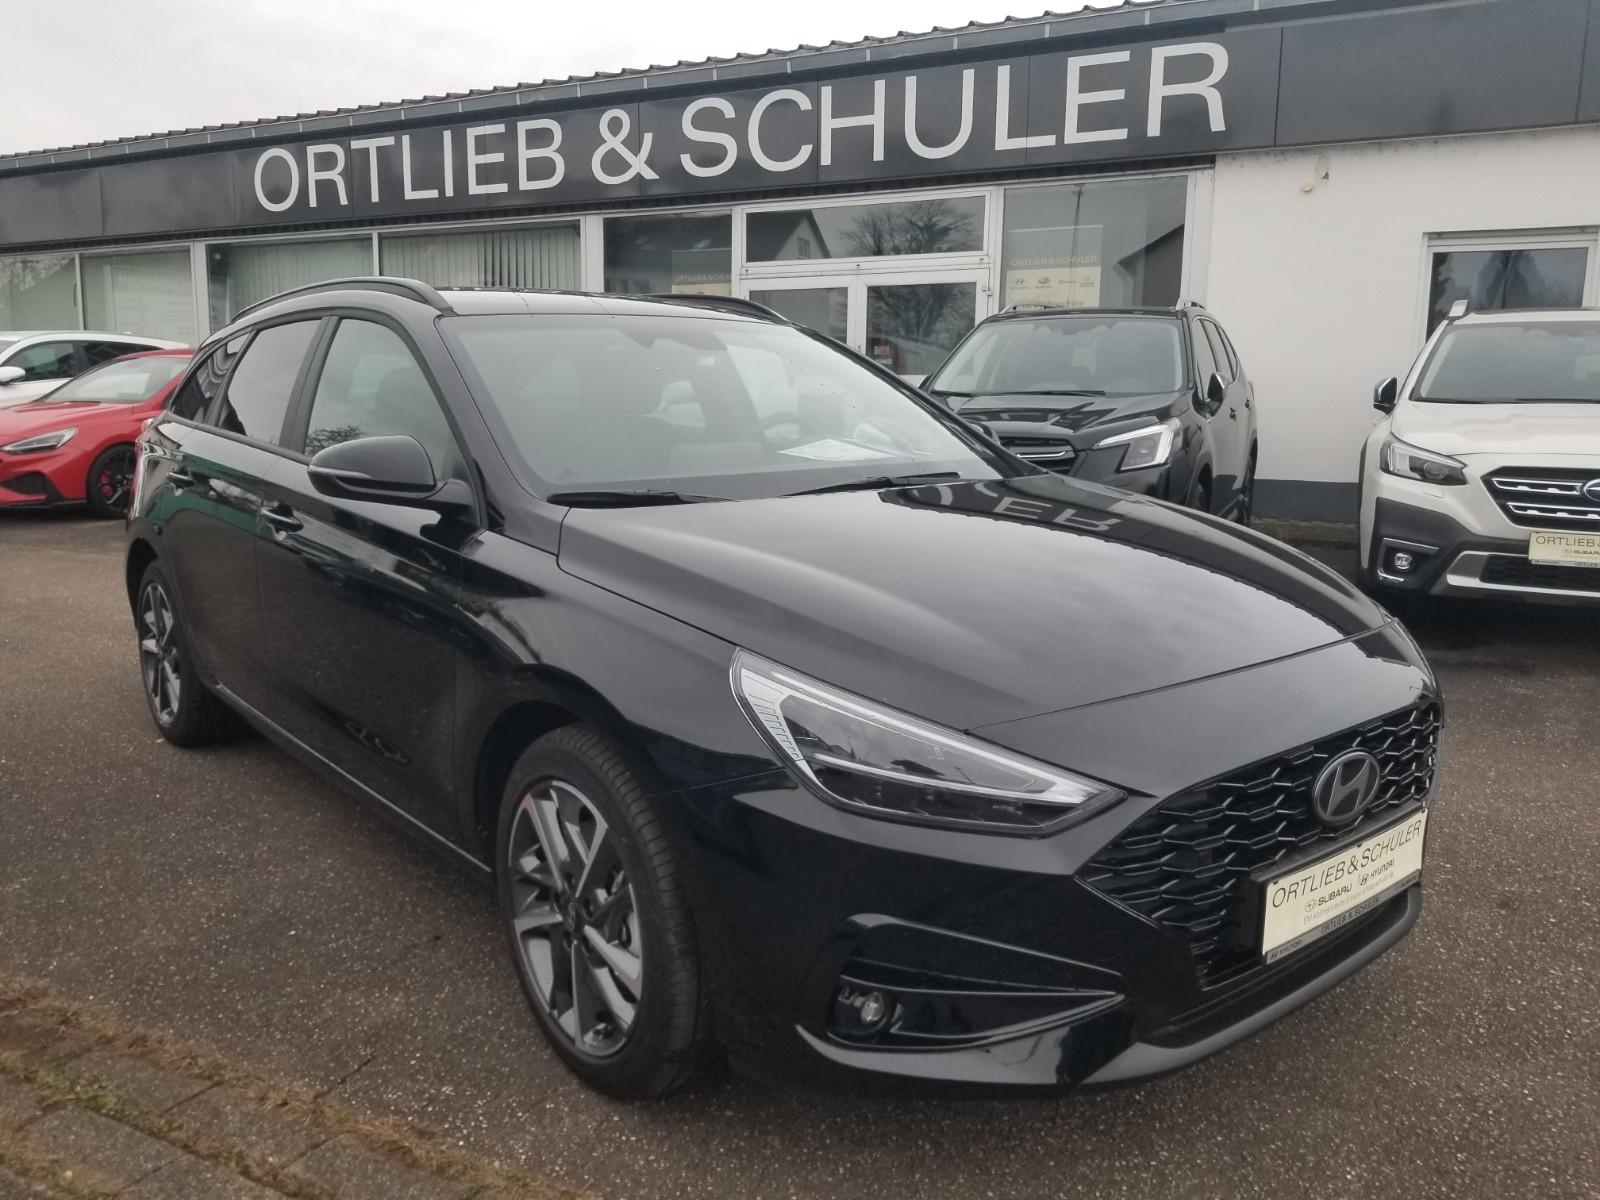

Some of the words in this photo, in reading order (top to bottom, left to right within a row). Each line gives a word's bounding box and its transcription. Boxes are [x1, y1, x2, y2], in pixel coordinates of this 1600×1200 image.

[254, 118, 565, 212] ORTLIEB
[591, 108, 660, 185] &
[679, 42, 1229, 178] SCHULER
[1535, 535, 1595, 547] ORTLIEB
[1272, 861, 1346, 908] ORTLIEB
[1347, 855, 1359, 875] &
[1360, 819, 1422, 868] SCHULER
[1317, 883, 1353, 906] SUBARU
